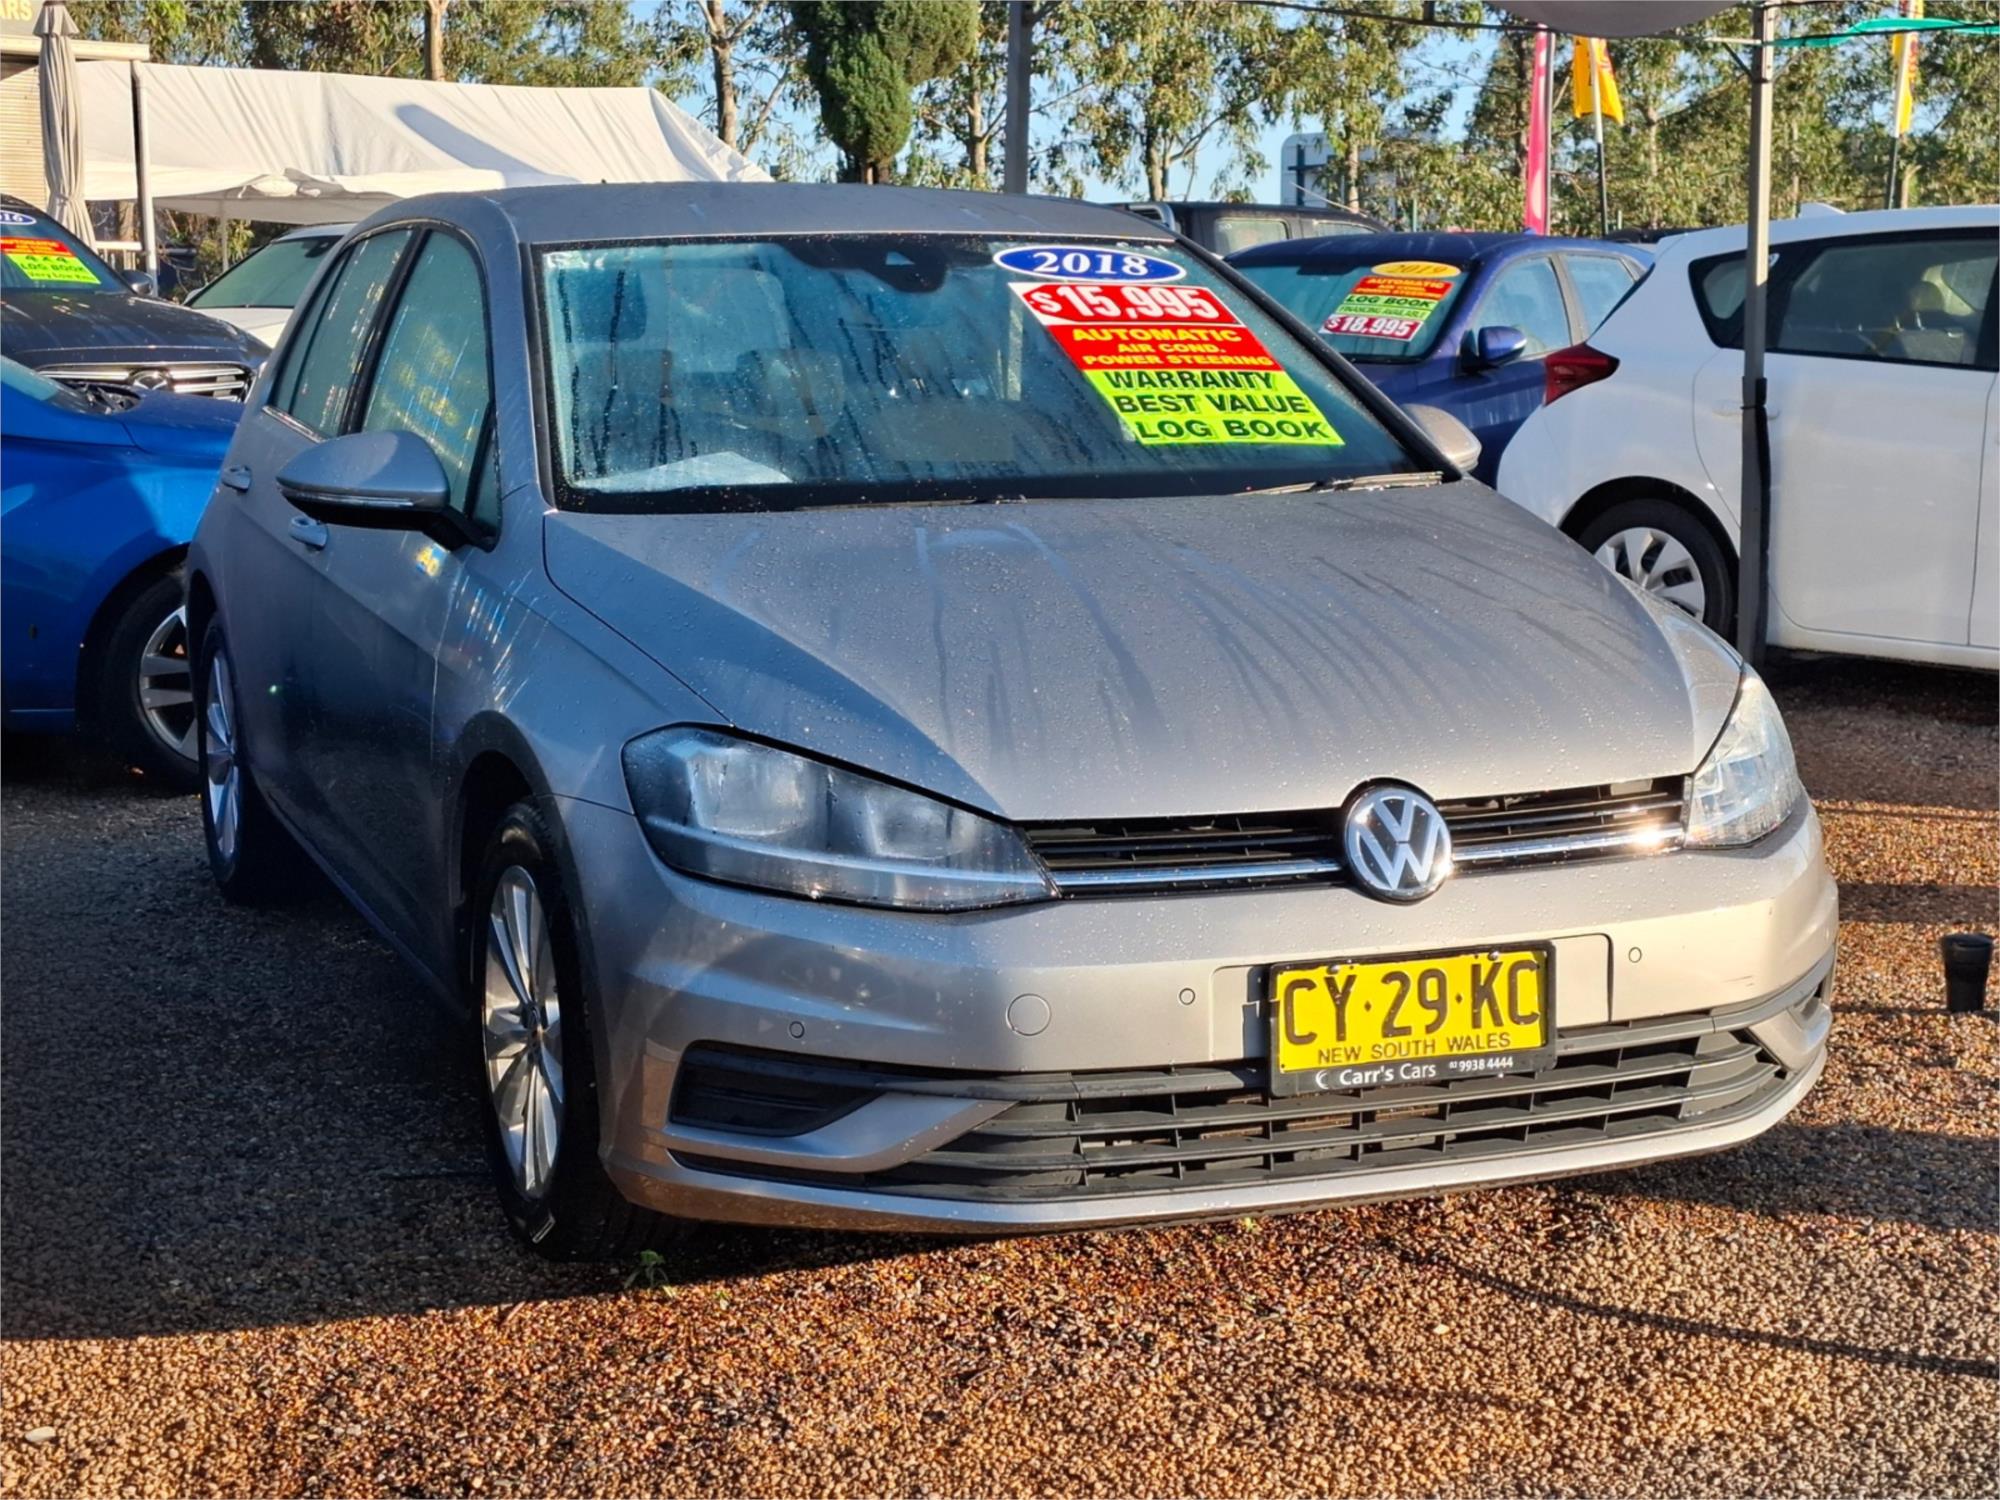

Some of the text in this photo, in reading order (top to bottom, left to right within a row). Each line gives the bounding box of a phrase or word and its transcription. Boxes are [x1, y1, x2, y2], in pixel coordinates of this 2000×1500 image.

[1032, 252, 1149, 276] 2018
[1389, 264, 1448, 275] 2019
[1365, 278, 1446, 289] AUTOMATIC
[1029, 285, 1220, 319] $15,995
[1346, 295, 1431, 307] LOG BOOK
[1072, 328, 1243, 343] AUTOMATIC
[1326, 316, 1414, 336] $18,995
[1118, 343, 1227, 353] AIR COND.
[1082, 355, 1275, 366] POWER STEERING
[1103, 370, 1275, 389] WARRANTY
[1112, 393, 1313, 414] BEST VALUE
[1135, 419, 1331, 439] LOG BOOK
[1317, 1032, 1511, 1065] NEW SOUTH WALES
[1339, 1065, 1395, 1086] Carr's
[1400, 1062, 1437, 1080] Cars
[1459, 1058, 1486, 1072] 9938
[1486, 1056, 1514, 1069] 4444
